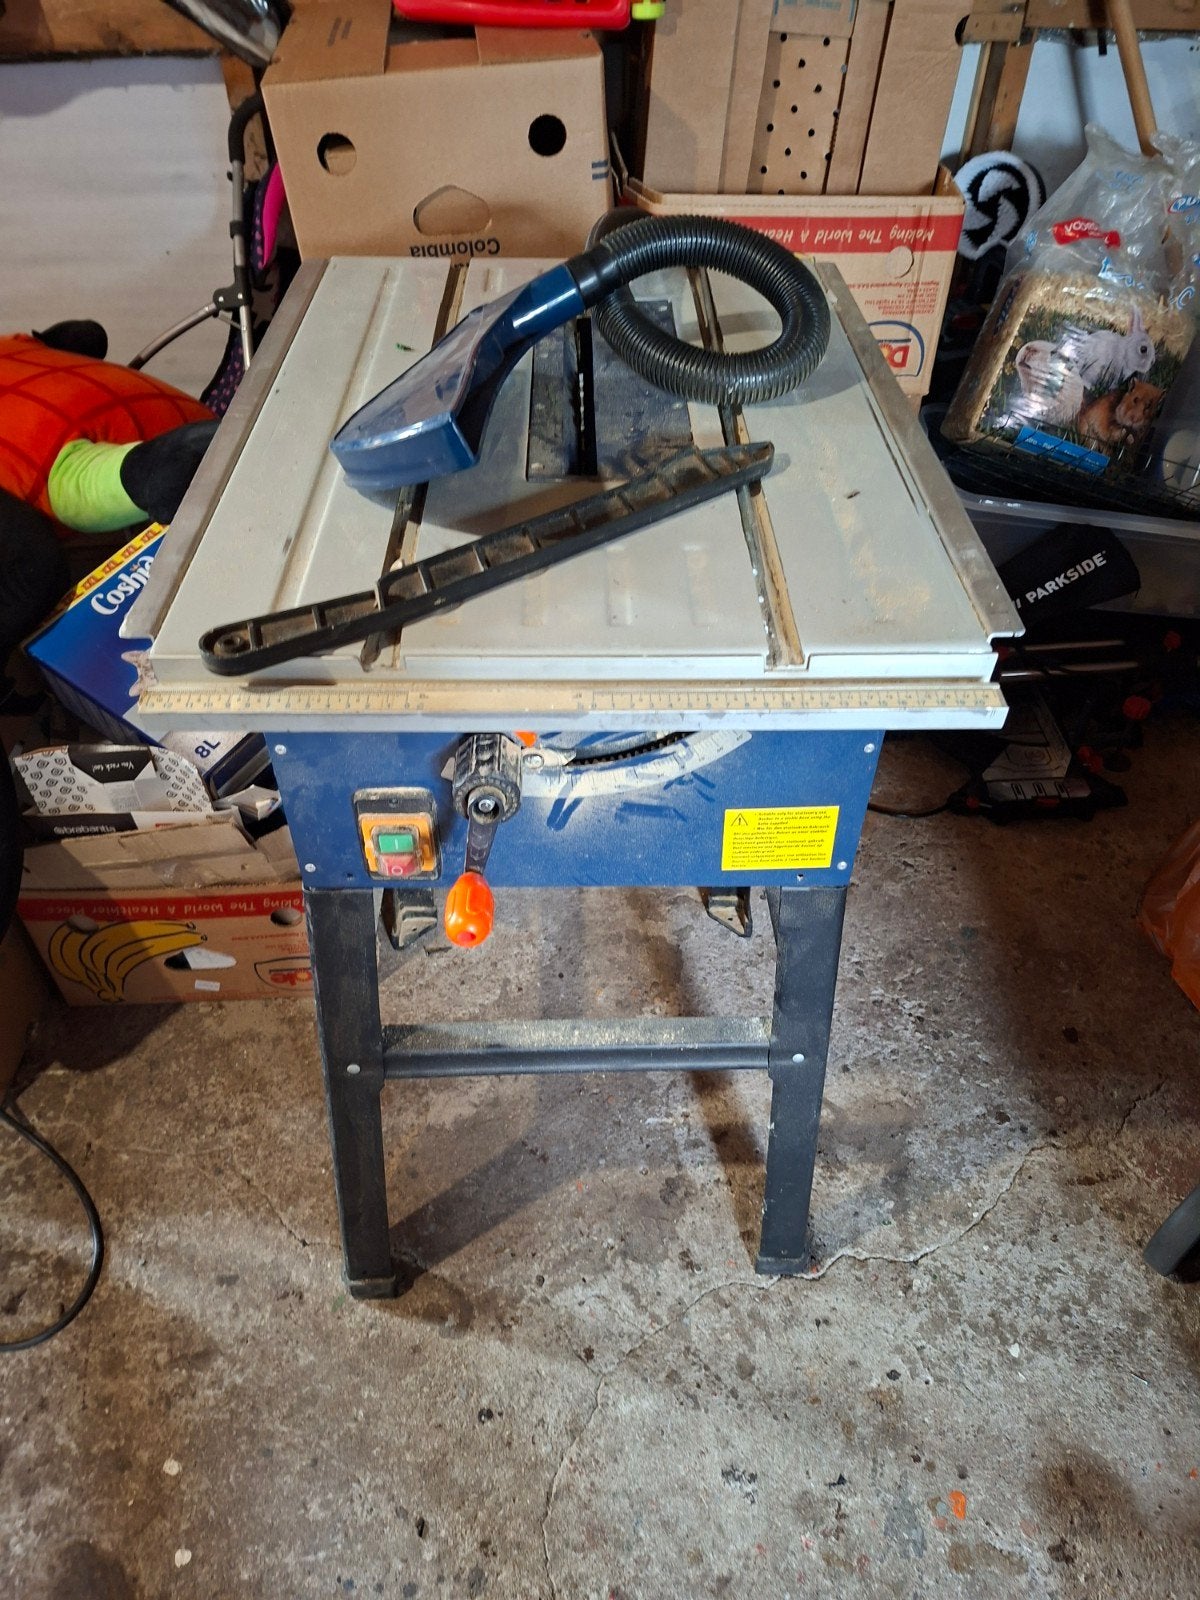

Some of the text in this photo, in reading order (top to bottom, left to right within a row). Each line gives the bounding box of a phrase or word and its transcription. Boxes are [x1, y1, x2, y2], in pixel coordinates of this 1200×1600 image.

[800, 228, 809, 244] A
[814, 228, 852, 245] World
[858, 228, 882, 244] The
[889, 225, 935, 243] Making
[409, 238, 500, 257] Colombia
[1025, 552, 1107, 603] PARKSIDE
[194, 740, 220, 758] 8L
[92, 905, 159, 916] Healthier
[166, 905, 173, 914] A
[184, 903, 223, 914] World
[230, 902, 256, 911] The
[263, 898, 304, 909] aking
[270, 971, 313, 986] ole
